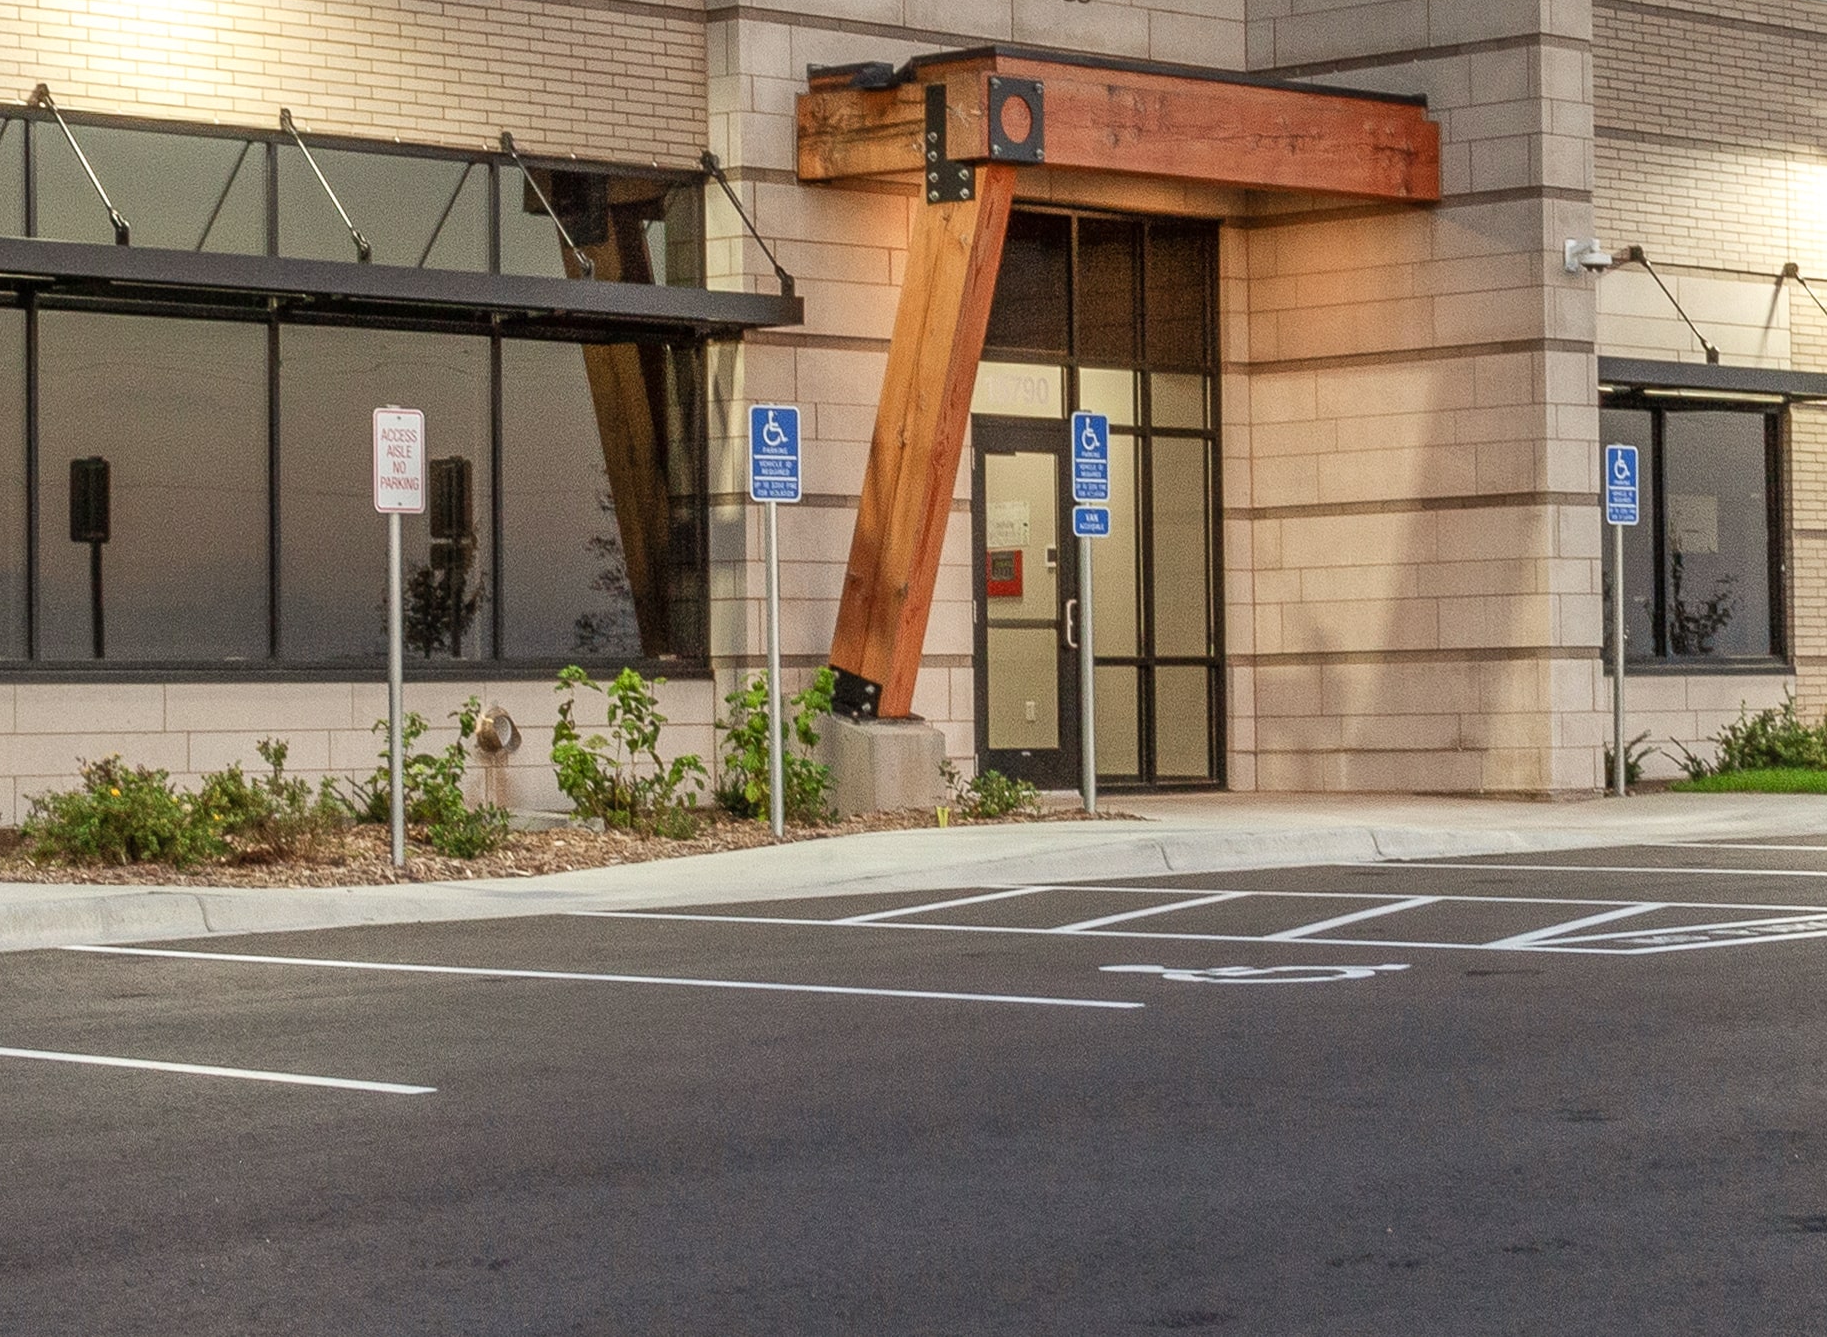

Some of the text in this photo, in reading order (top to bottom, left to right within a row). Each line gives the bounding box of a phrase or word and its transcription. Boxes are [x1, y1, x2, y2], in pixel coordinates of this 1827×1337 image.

[381, 428, 418, 443] ACCESS
[386, 444, 412, 458] AISLE
[392, 460, 407, 474] NO
[380, 476, 419, 491] PARKING
[1085, 513, 1099, 522] VAN
